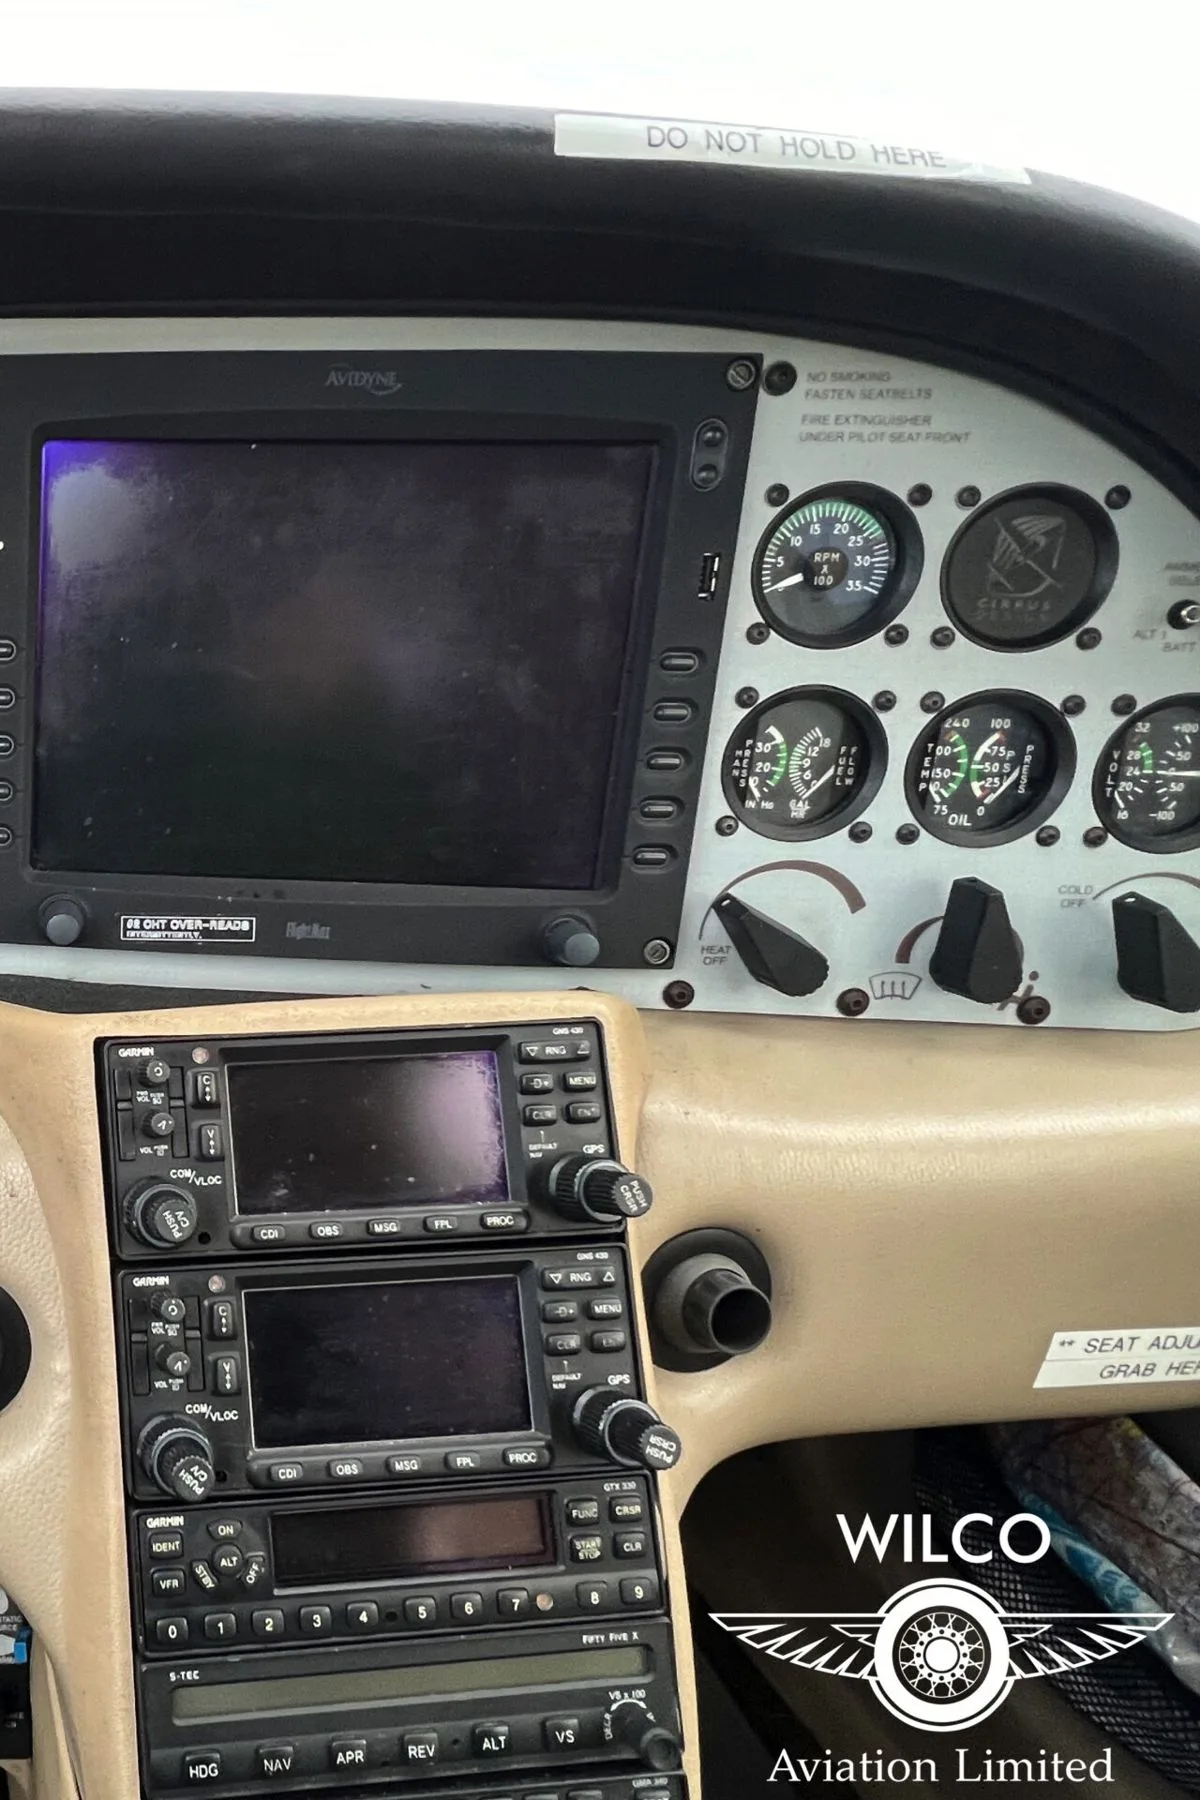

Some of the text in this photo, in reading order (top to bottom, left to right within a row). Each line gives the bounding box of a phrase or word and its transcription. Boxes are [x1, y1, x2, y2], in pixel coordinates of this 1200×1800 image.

[646, 126, 947, 168] DO NOT HOLD HERE
[325, 371, 397, 386] AVIDYNE
[807, 372, 890, 382] NO SMOKING
[805, 389, 933, 399] FASTEN SEATBELTS
[802, 415, 932, 426] FIRE EXTINGUISHER
[799, 432, 844, 442] UNDER
[848, 432, 885, 442] PILOT
[923, 432, 972, 442] FRONT
[810, 524, 849, 534] 15 20
[790, 536, 802, 547] 10
[848, 536, 863, 547] 25
[814, 553, 840, 562] RPM
[855, 556, 871, 566] 30
[814, 576, 833, 585] 100
[846, 581, 862, 591] 35
[944, 718, 970, 728] 240
[991, 718, 1011, 728] 100
[932, 768, 950, 778] 150
[1126, 766, 1140, 776] 24
[1118, 782, 1133, 792] 20
[1169, 783, 1185, 792] 50
[789, 801, 811, 810] GAL
[948, 815, 972, 826] OIL
[1058, 885, 1093, 895] COLD
[701, 945, 732, 954] HEAT
[703, 956, 727, 965] OFF
[119, 1047, 154, 1057] GARMIN
[545, 1046, 567, 1055] RNG
[569, 1076, 596, 1085] MENU
[582, 1145, 605, 1154] GPS
[434, 1218, 453, 1229] FPL
[486, 1214, 514, 1226] PROC
[317, 1225, 339, 1237] OBS
[374, 1222, 398, 1234] MSG
[260, 1229, 278, 1240] CDI
[132, 1276, 169, 1287] GARMIN
[570, 1272, 592, 1282] RNG
[594, 1304, 622, 1314] MENU
[1084, 1336, 1140, 1354] SEAT
[1099, 1363, 1157, 1379] GRAB
[607, 1375, 630, 1385] GPS
[456, 1456, 475, 1468] FPL
[508, 1451, 537, 1463] PROC
[336, 1464, 359, 1476] OBS
[394, 1460, 418, 1471] MSG
[278, 1468, 297, 1479] CDI
[603, 1482, 620, 1493] GTX
[572, 1508, 598, 1519] FUNC
[615, 1505, 641, 1516] CRSR
[146, 1515, 184, 1528] GARMIN
[218, 1525, 234, 1535] ON
[152, 1540, 180, 1552] IDENT
[575, 1538, 601, 1550] START
[623, 1542, 642, 1552] CLR
[578, 1550, 601, 1560] STOP
[220, 1556, 238, 1567] ALT
[195, 1565, 215, 1589] STBY
[159, 1578, 179, 1589] VFR
[582, 1632, 628, 1645] FIFTY FIVE
[555, 1729, 575, 1744] VS
[482, 1736, 507, 1751] ALT
[408, 1744, 435, 1759] REV
[336, 1750, 365, 1765] APR
[263, 1757, 292, 1772] NAV
[189, 1763, 219, 1778] HDG
